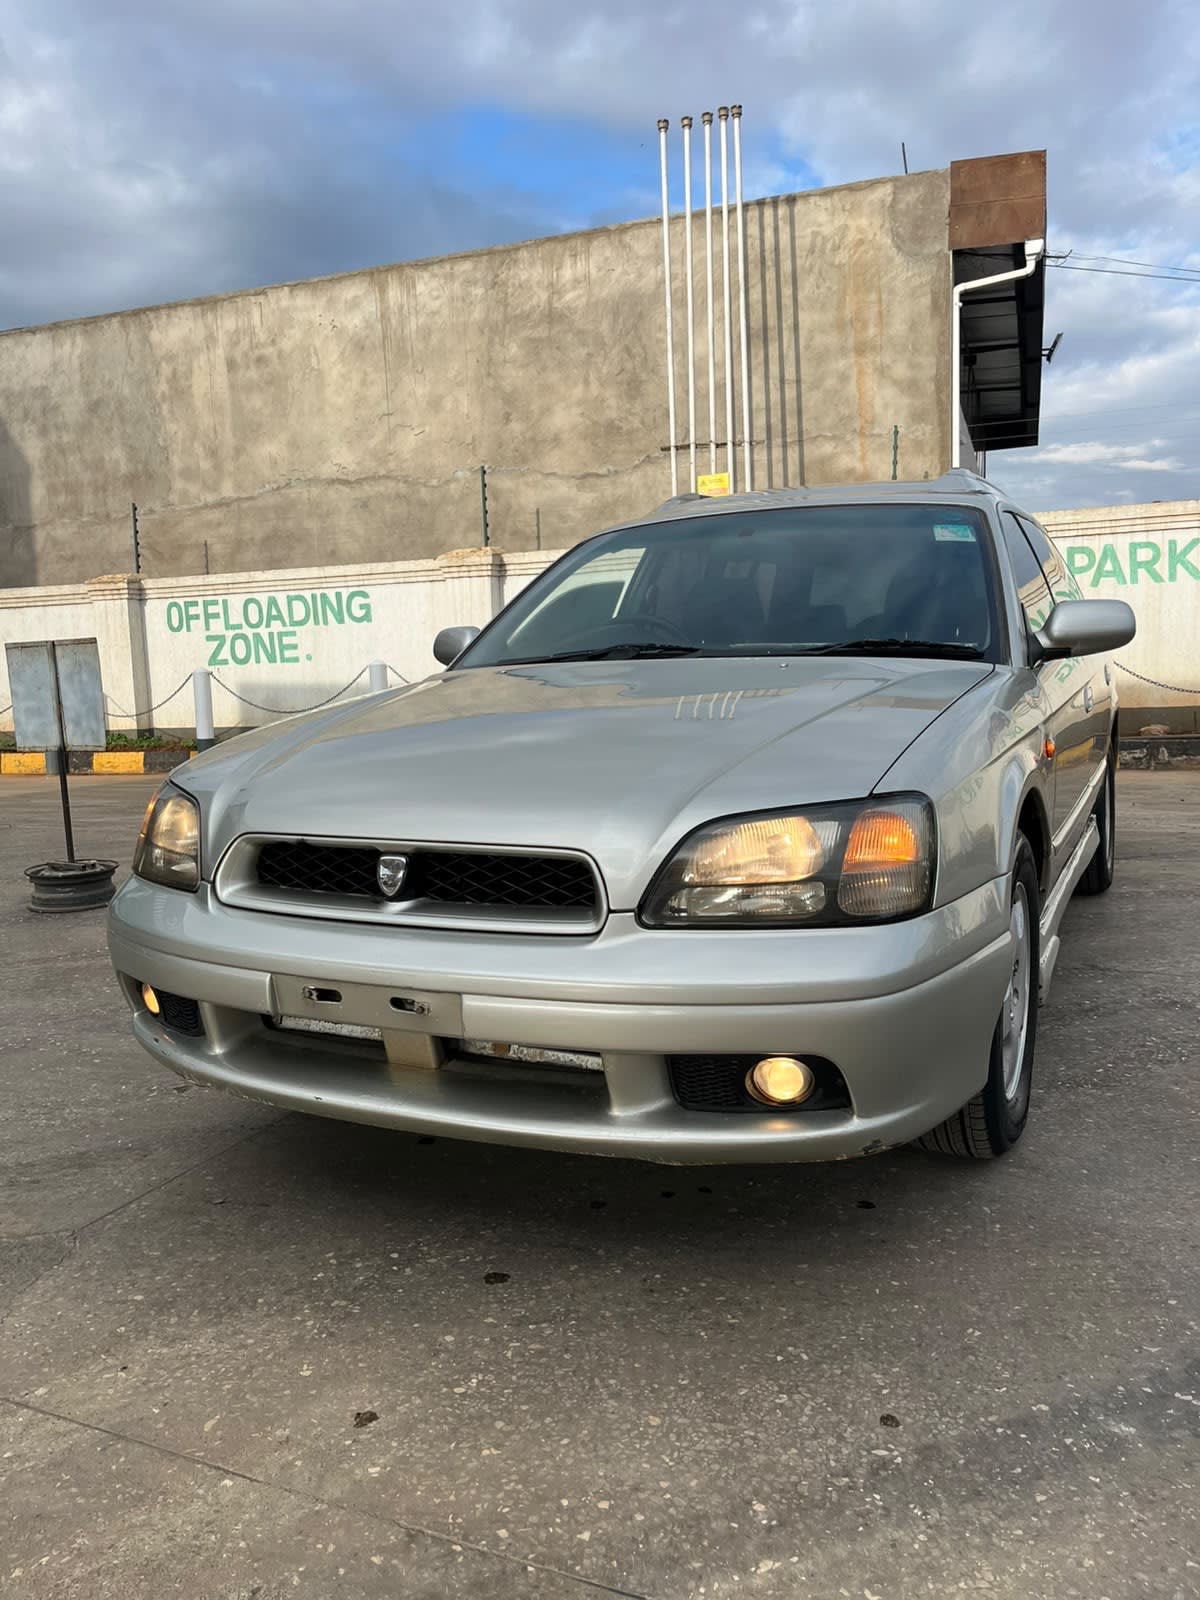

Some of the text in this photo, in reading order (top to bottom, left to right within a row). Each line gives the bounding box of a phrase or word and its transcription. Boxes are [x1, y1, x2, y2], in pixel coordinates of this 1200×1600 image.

[1066, 538, 1200, 588] PARK
[166, 590, 372, 632] OFFLOADING
[205, 631, 312, 666] ZONE.
